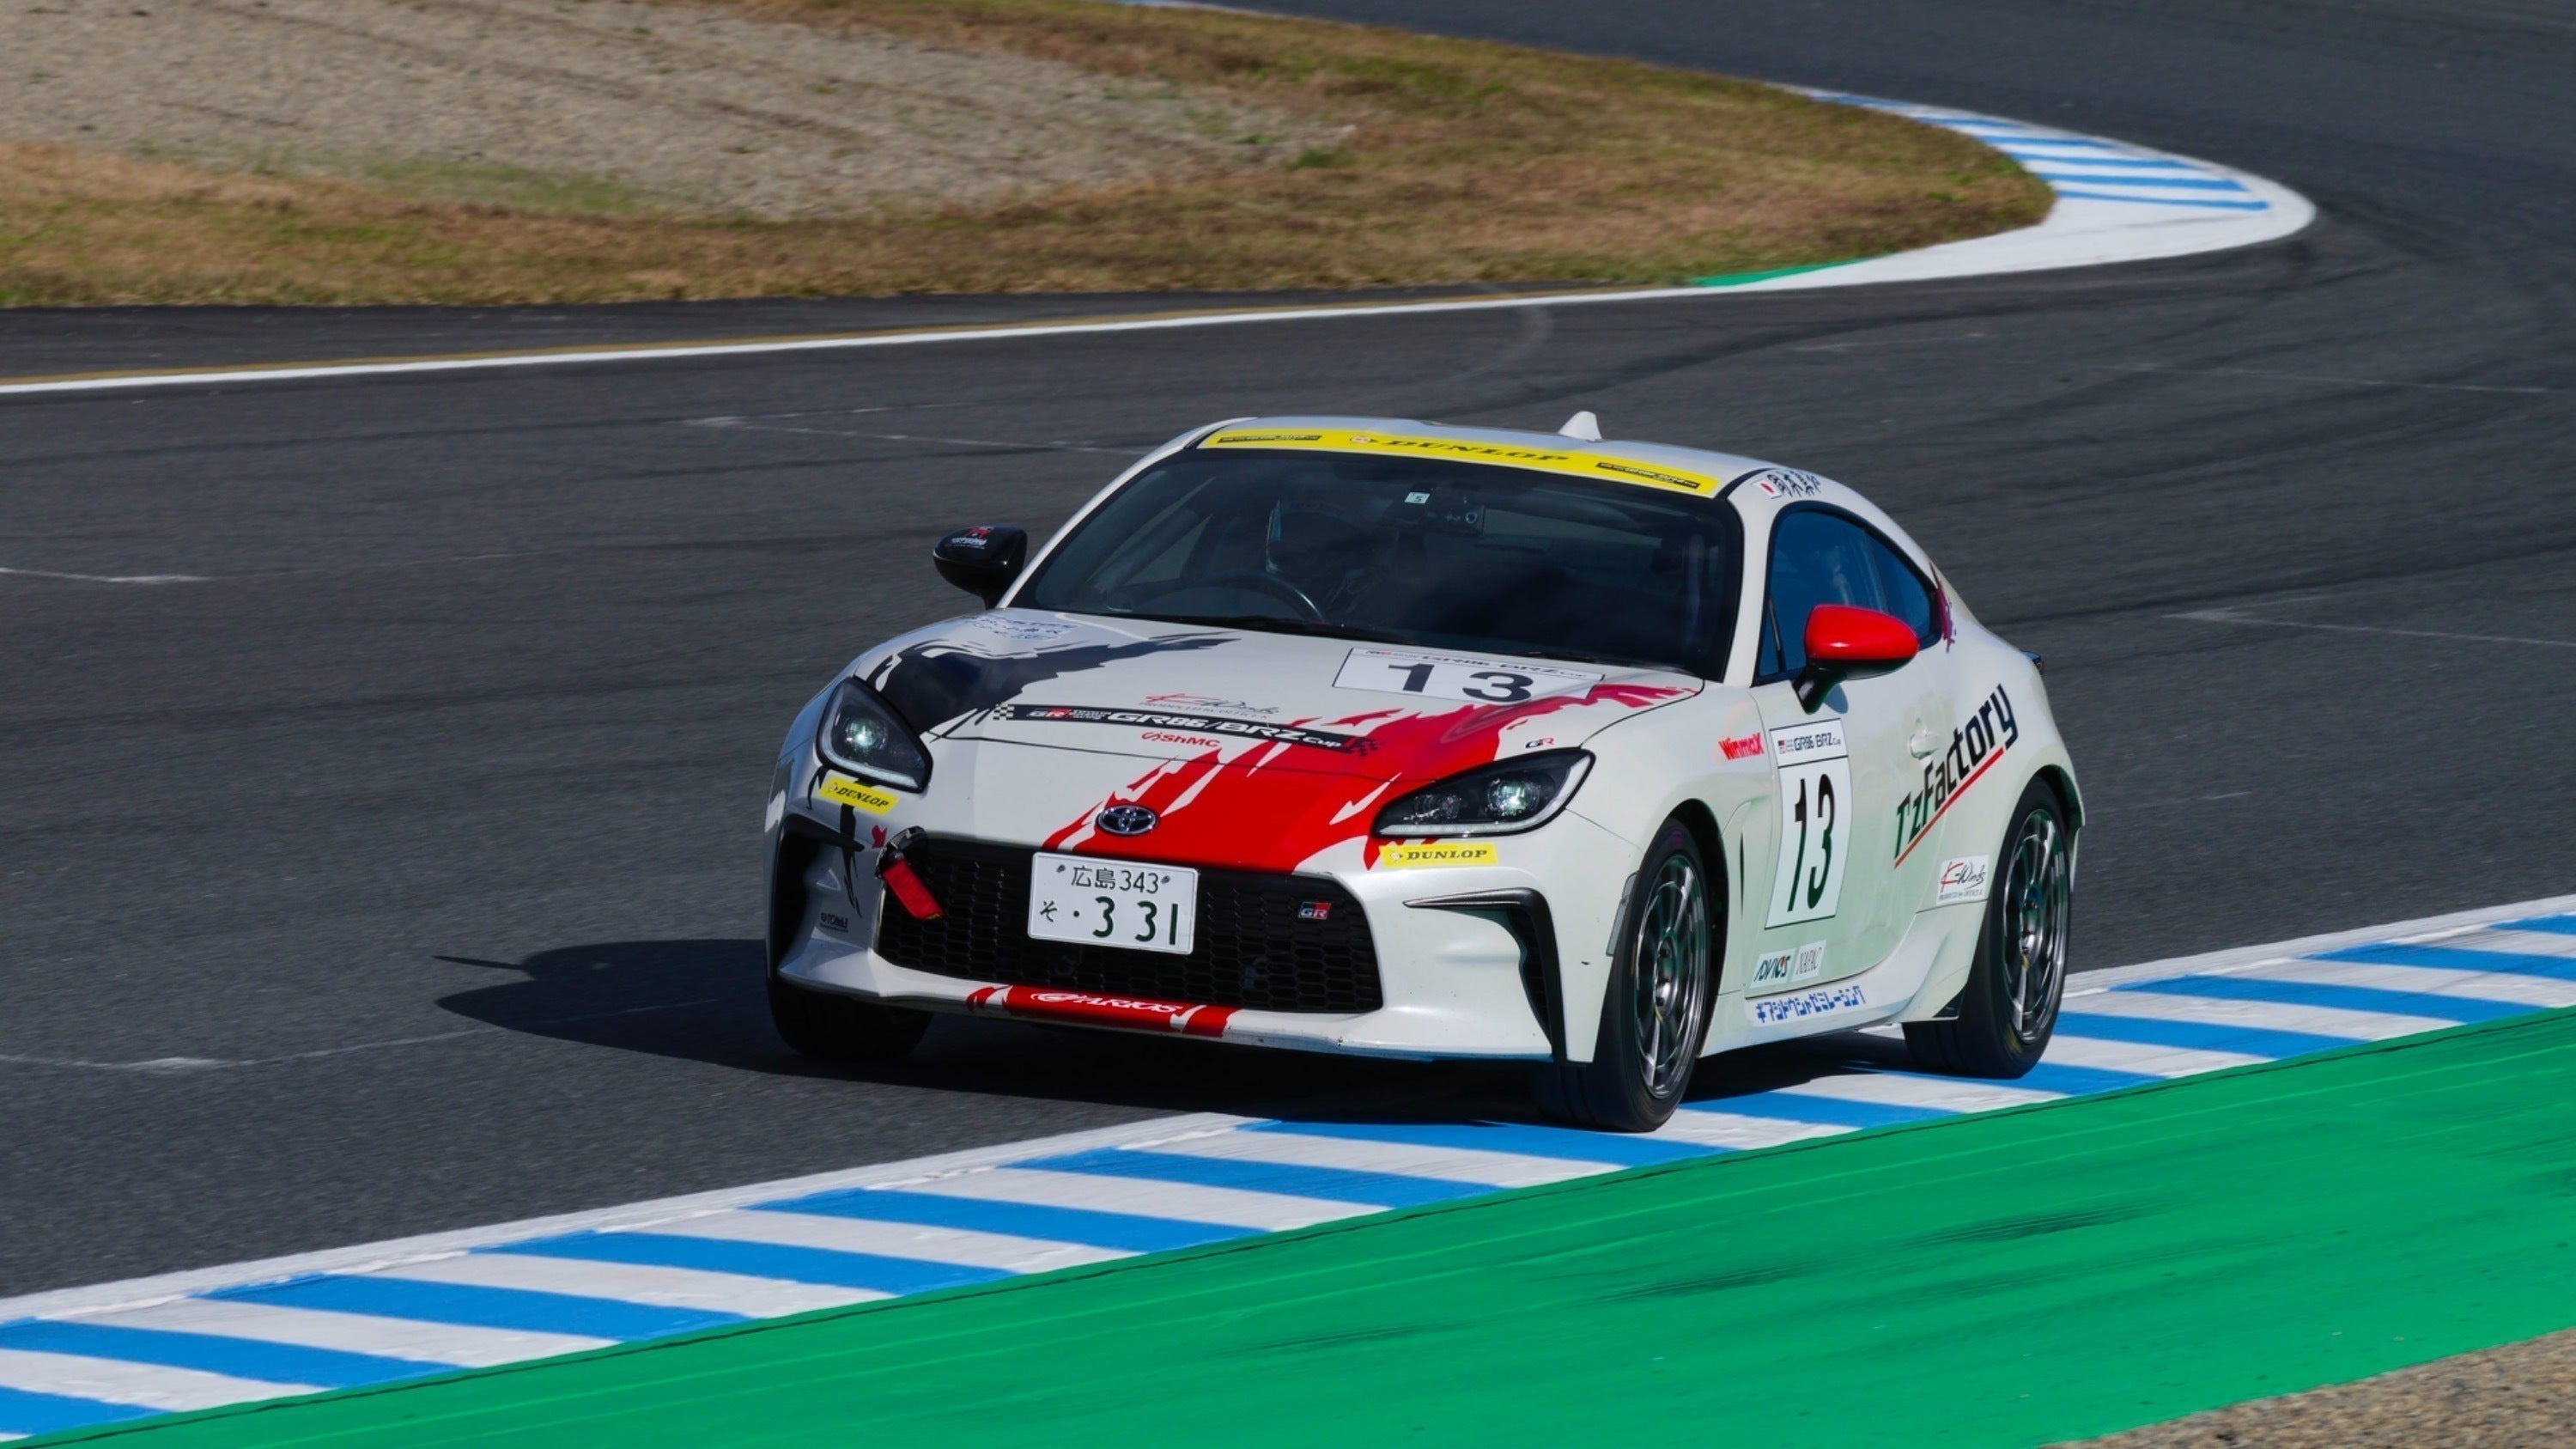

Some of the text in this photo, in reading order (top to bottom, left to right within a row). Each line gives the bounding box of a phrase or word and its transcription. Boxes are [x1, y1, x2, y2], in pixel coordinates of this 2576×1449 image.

[1387, 441, 1569, 461] DUNLOP
[1388, 663, 1534, 703] 13
[1302, 736, 1342, 748] Cup
[1815, 733, 1832, 748] BRZ
[836, 787, 890, 808] DUNLOP
[1788, 774, 1835, 912] 13
[1406, 850, 1487, 860] DUNLOP
[1040, 900, 1058, 922] そ
